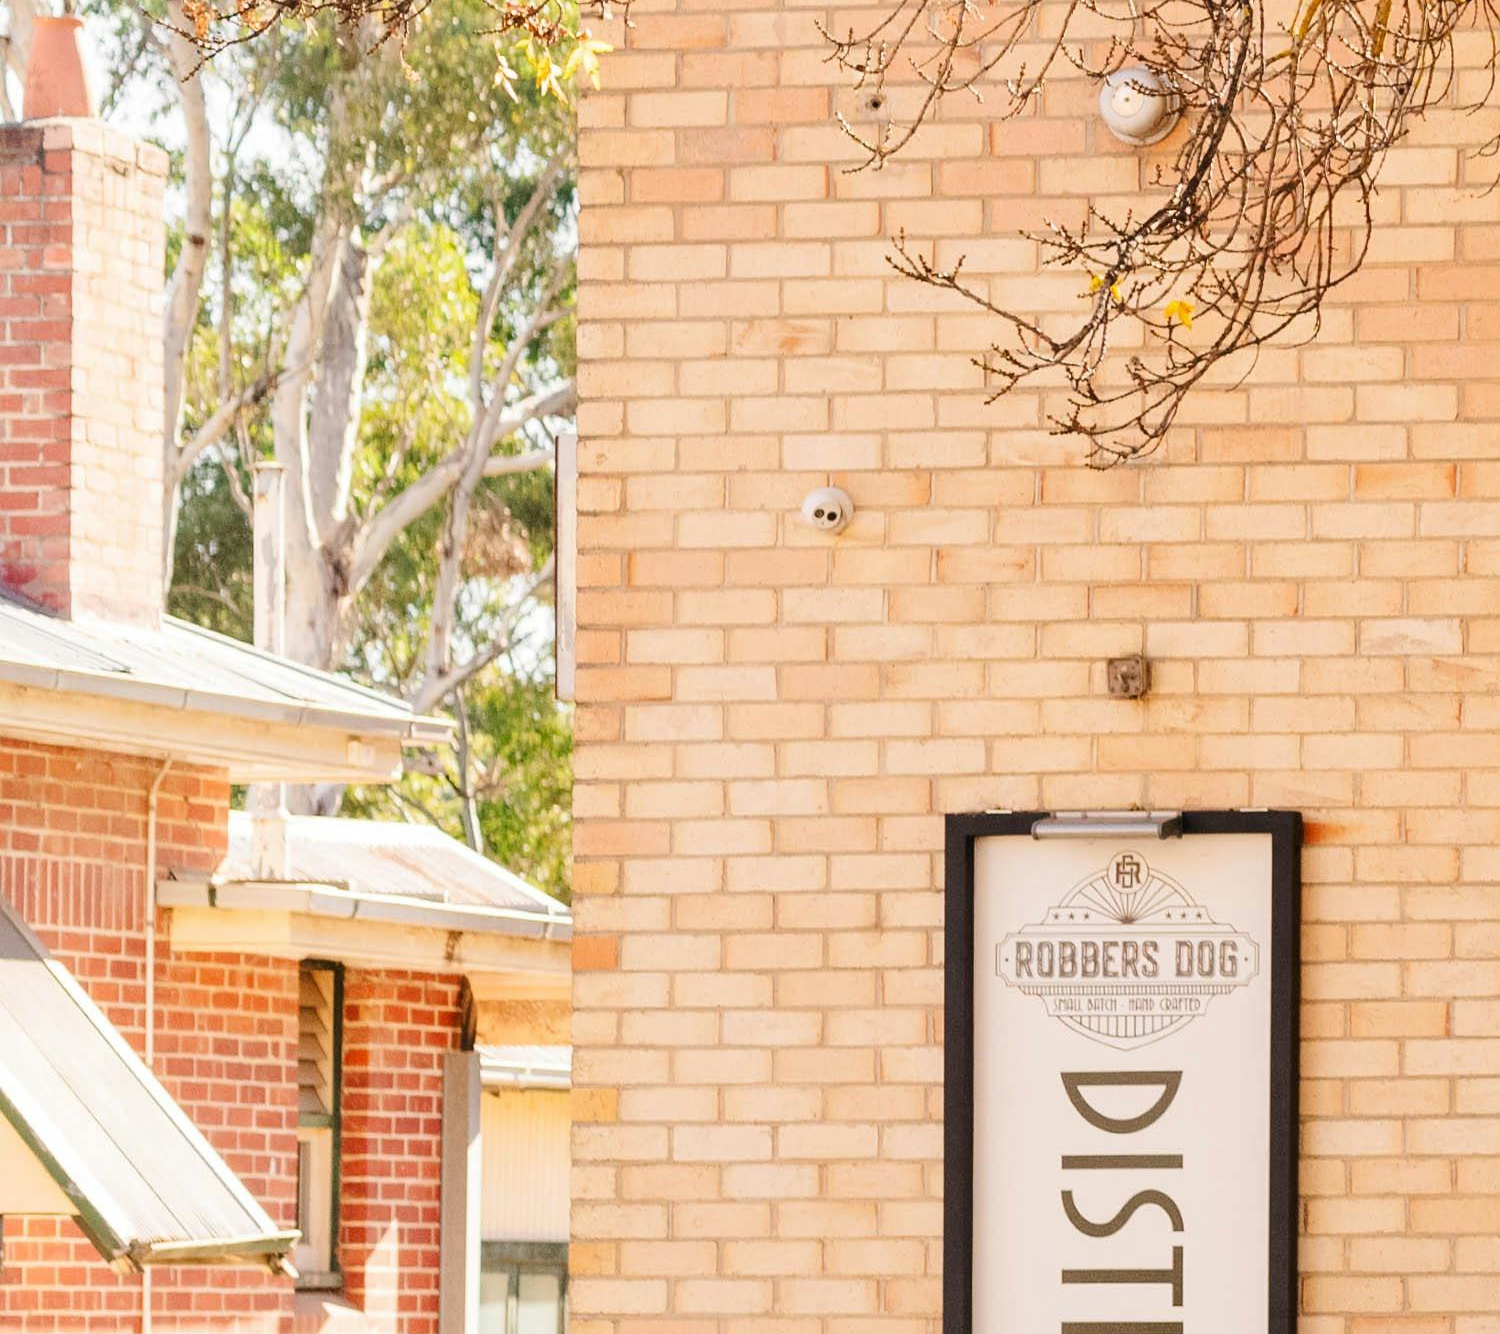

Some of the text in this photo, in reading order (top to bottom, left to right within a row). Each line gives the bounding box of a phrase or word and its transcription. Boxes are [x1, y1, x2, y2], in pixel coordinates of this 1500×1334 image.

[1015, 940, 1239, 979] ROBBERS DOG
[1053, 997, 1201, 1012] SMALL BATCH HAND CRAFTED
